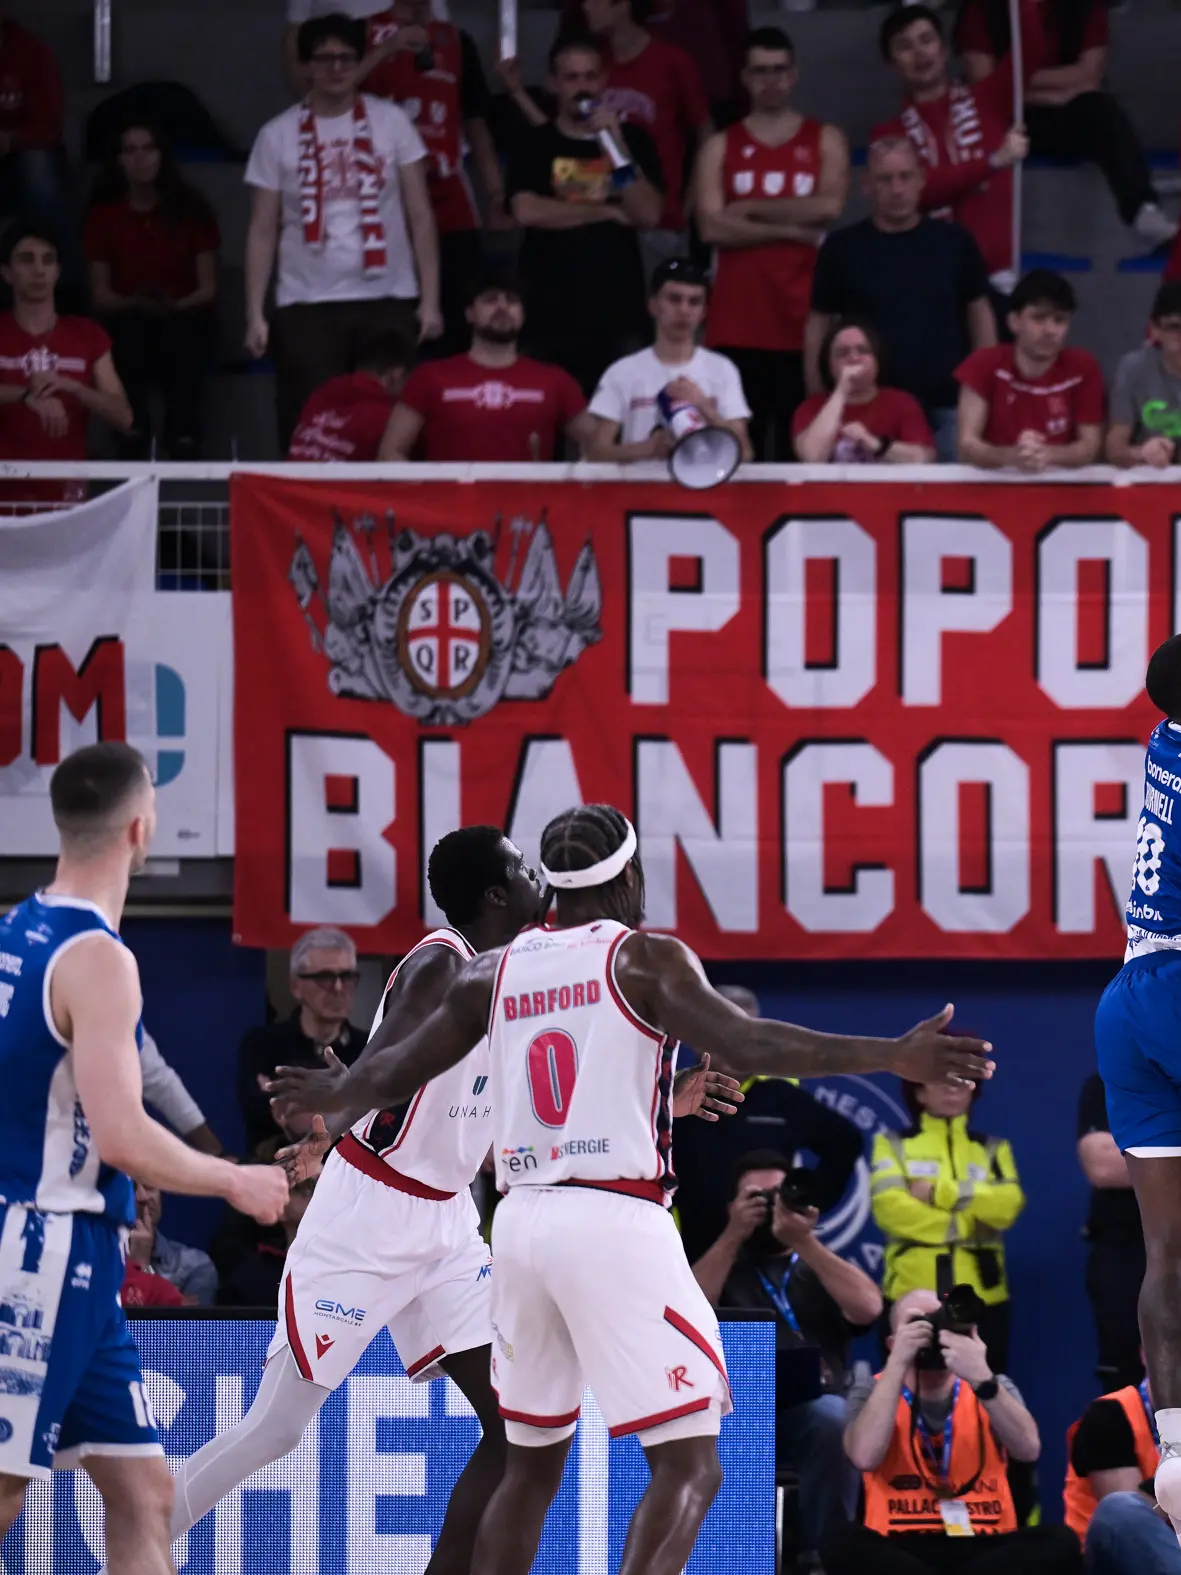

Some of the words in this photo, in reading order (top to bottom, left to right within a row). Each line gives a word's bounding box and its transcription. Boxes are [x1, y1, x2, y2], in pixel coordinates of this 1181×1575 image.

[503, 979, 602, 1023] BARFORD
[526, 1027, 580, 1130] 0
[315, 1299, 367, 1322] GME
[888, 1498, 1002, 1515] PALLACSTRO
